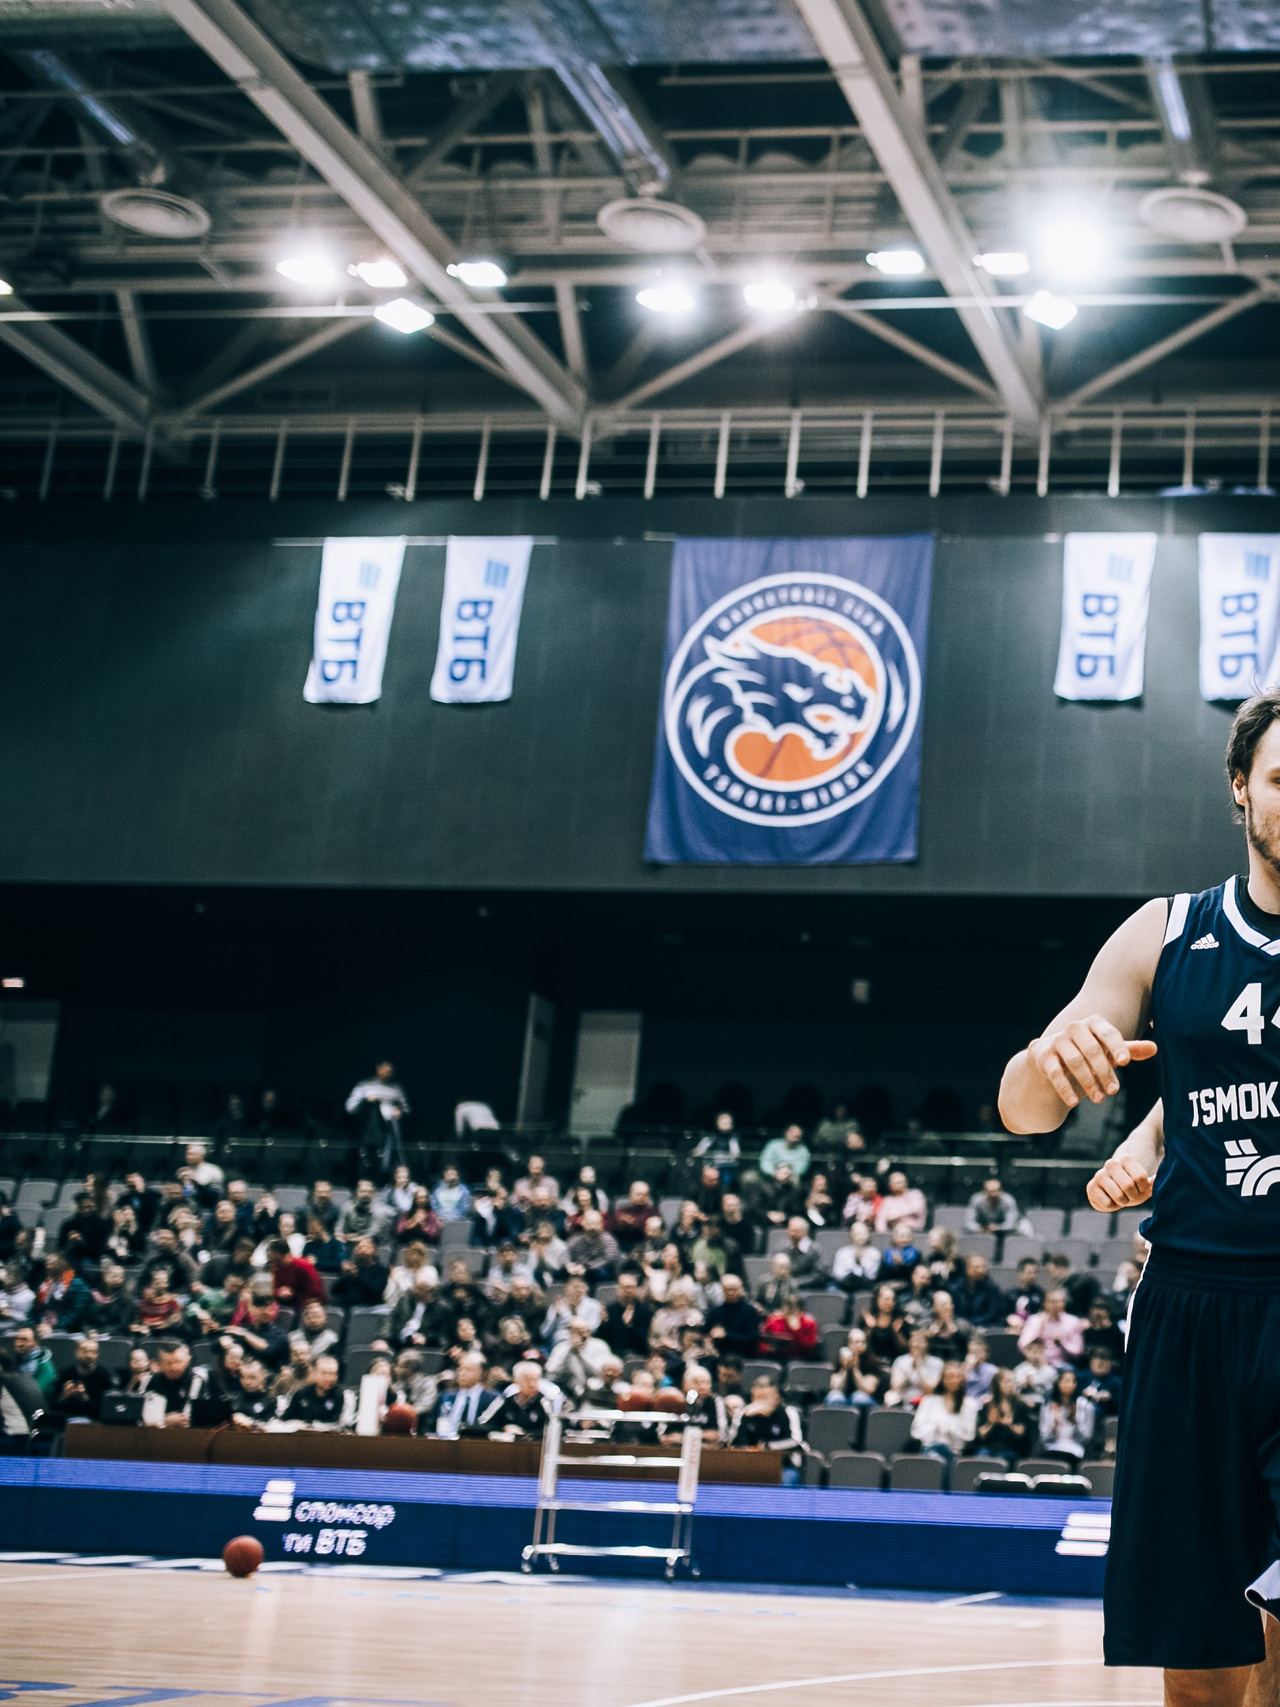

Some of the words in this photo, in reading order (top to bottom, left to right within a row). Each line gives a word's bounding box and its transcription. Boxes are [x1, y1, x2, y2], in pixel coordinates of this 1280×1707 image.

[321, 601, 366, 682] ВТБ
[449, 600, 494, 682] ВТБ
[1076, 593, 1119, 678] ВТБ
[1219, 592, 1258, 678] ВТБ
[295, 1501, 396, 1530] спонсор
[314, 1528, 369, 1556] ВТБ
